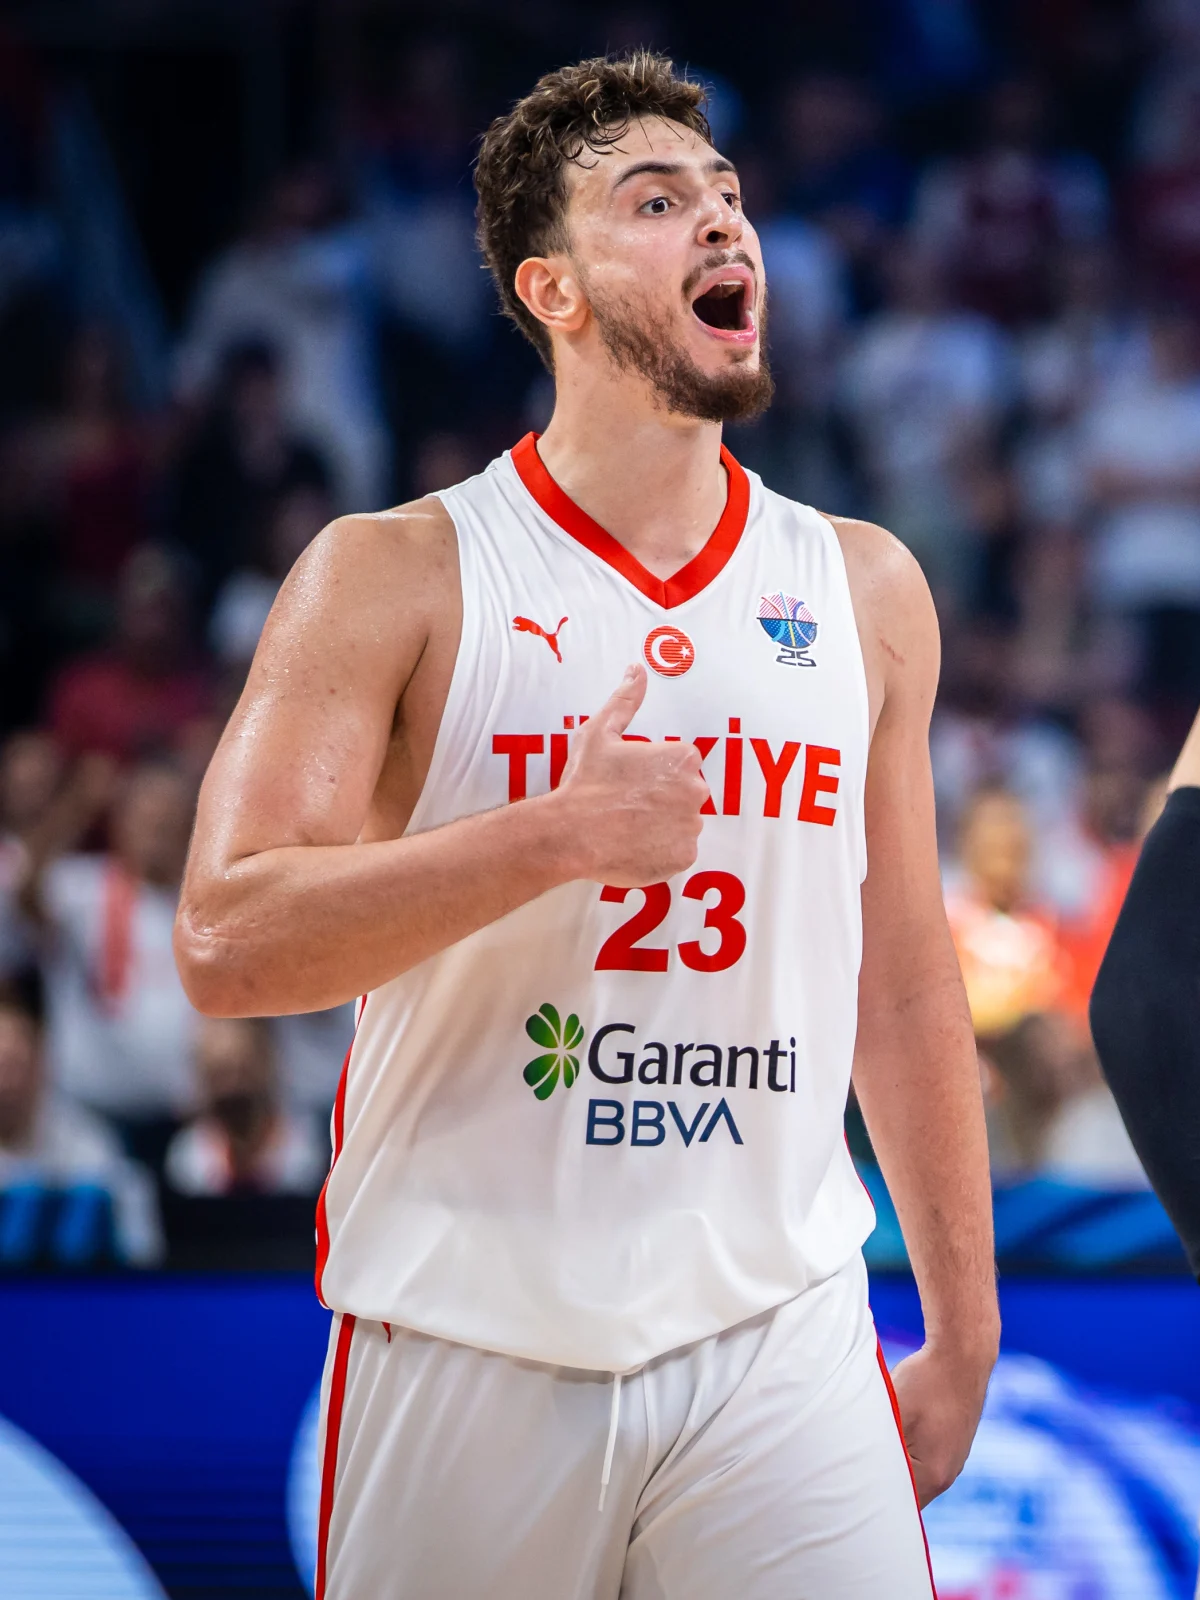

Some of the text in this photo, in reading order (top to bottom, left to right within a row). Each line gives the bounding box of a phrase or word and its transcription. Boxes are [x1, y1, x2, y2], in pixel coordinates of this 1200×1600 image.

[594, 870, 747, 973] 23
[588, 1022, 796, 1093] Garanti
[586, 1097, 744, 1148] BBVA
